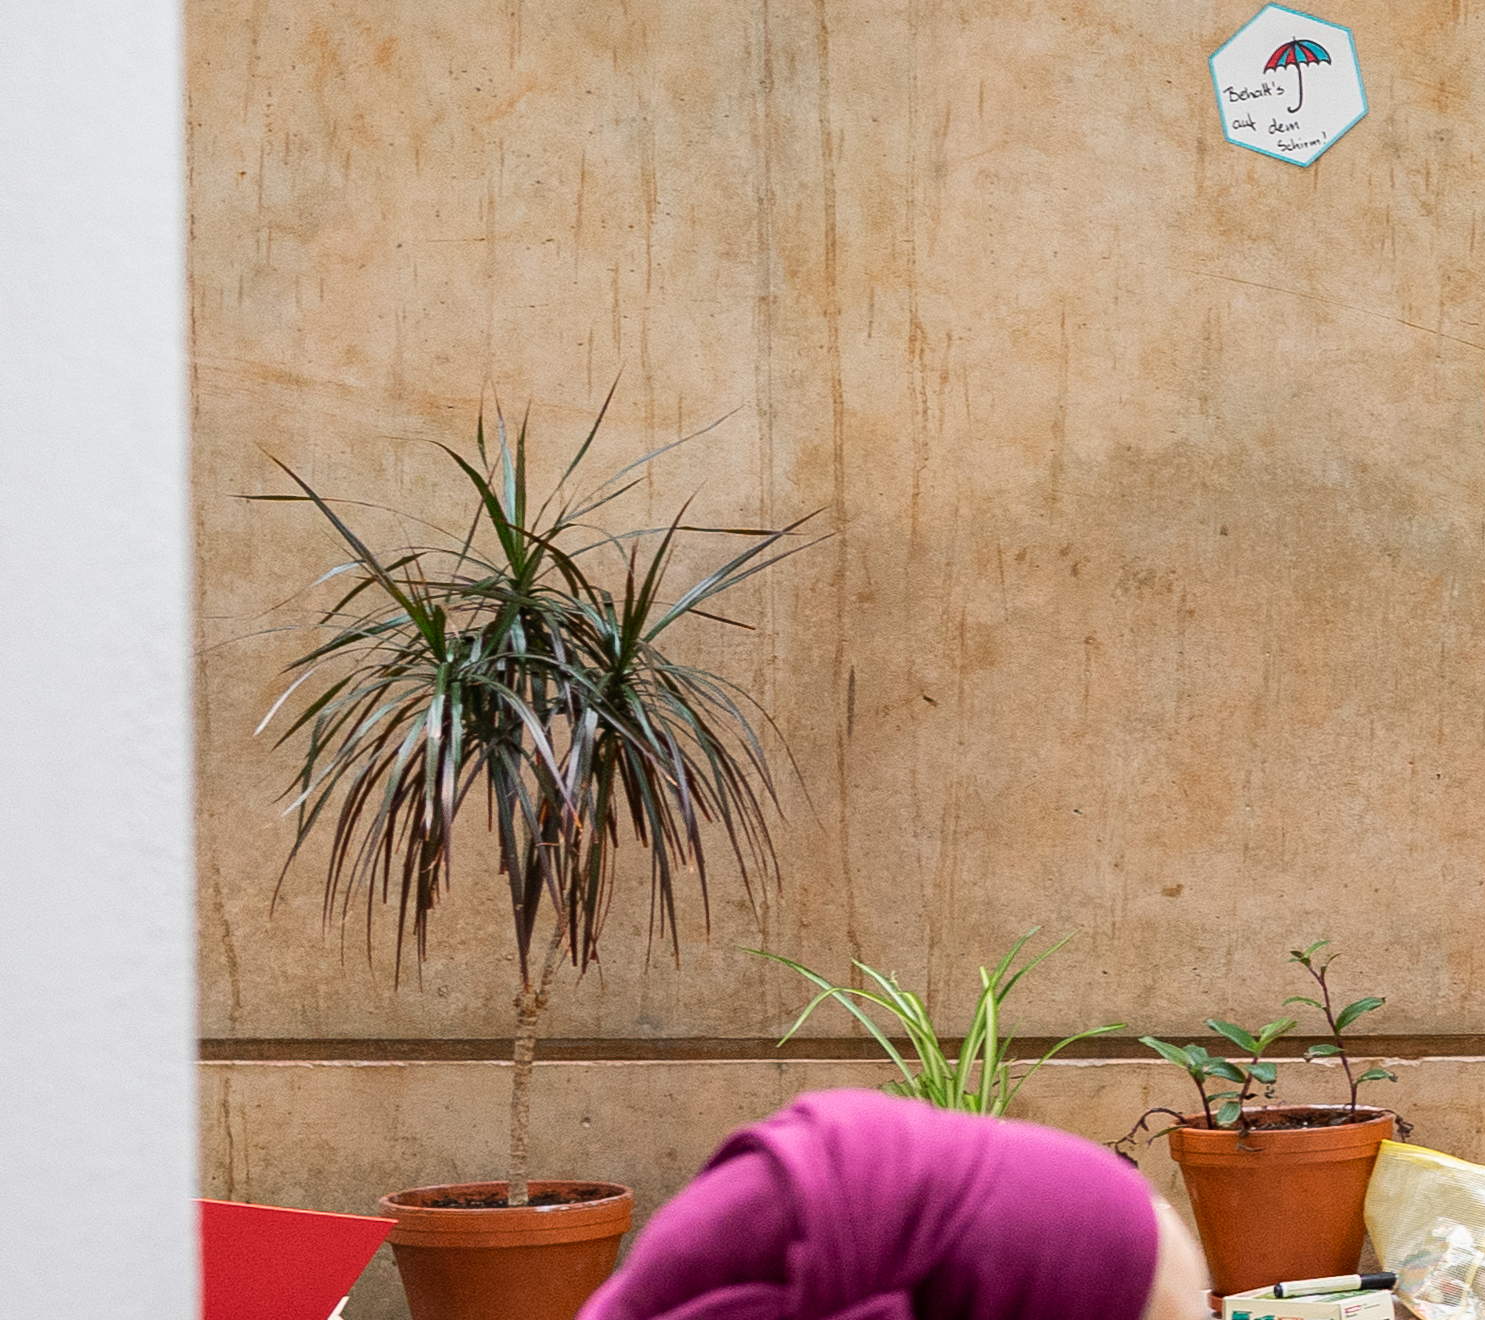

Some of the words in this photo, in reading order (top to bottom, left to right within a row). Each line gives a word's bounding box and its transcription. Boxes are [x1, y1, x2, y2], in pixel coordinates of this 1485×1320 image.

[1232, 113, 1257, 132] auf
[1268, 118, 1300, 135] dem
[1277, 130, 1329, 154] Schirm!
